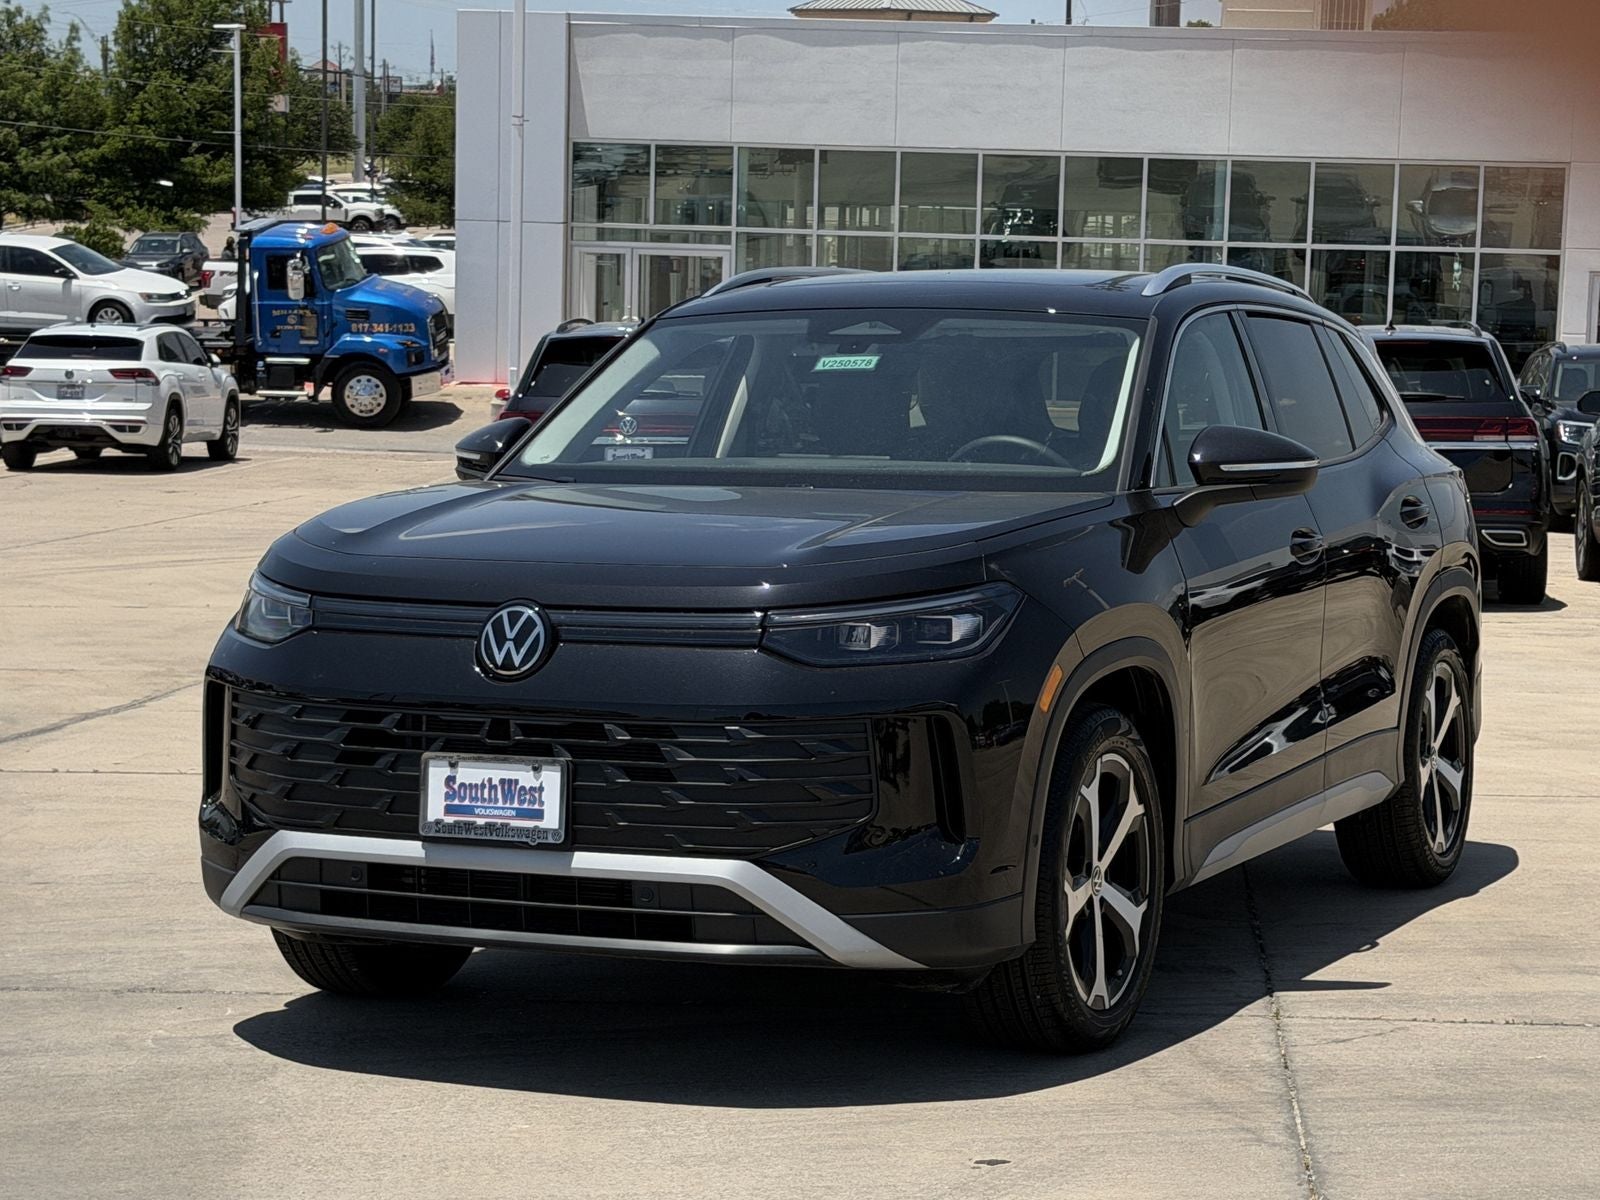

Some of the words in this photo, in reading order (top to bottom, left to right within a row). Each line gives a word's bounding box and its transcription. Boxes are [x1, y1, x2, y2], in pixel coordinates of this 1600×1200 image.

[822, 359, 873, 368] V250578
[444, 774, 545, 807] SouthWest
[474, 807, 517, 817] VOLKSWAGEN
